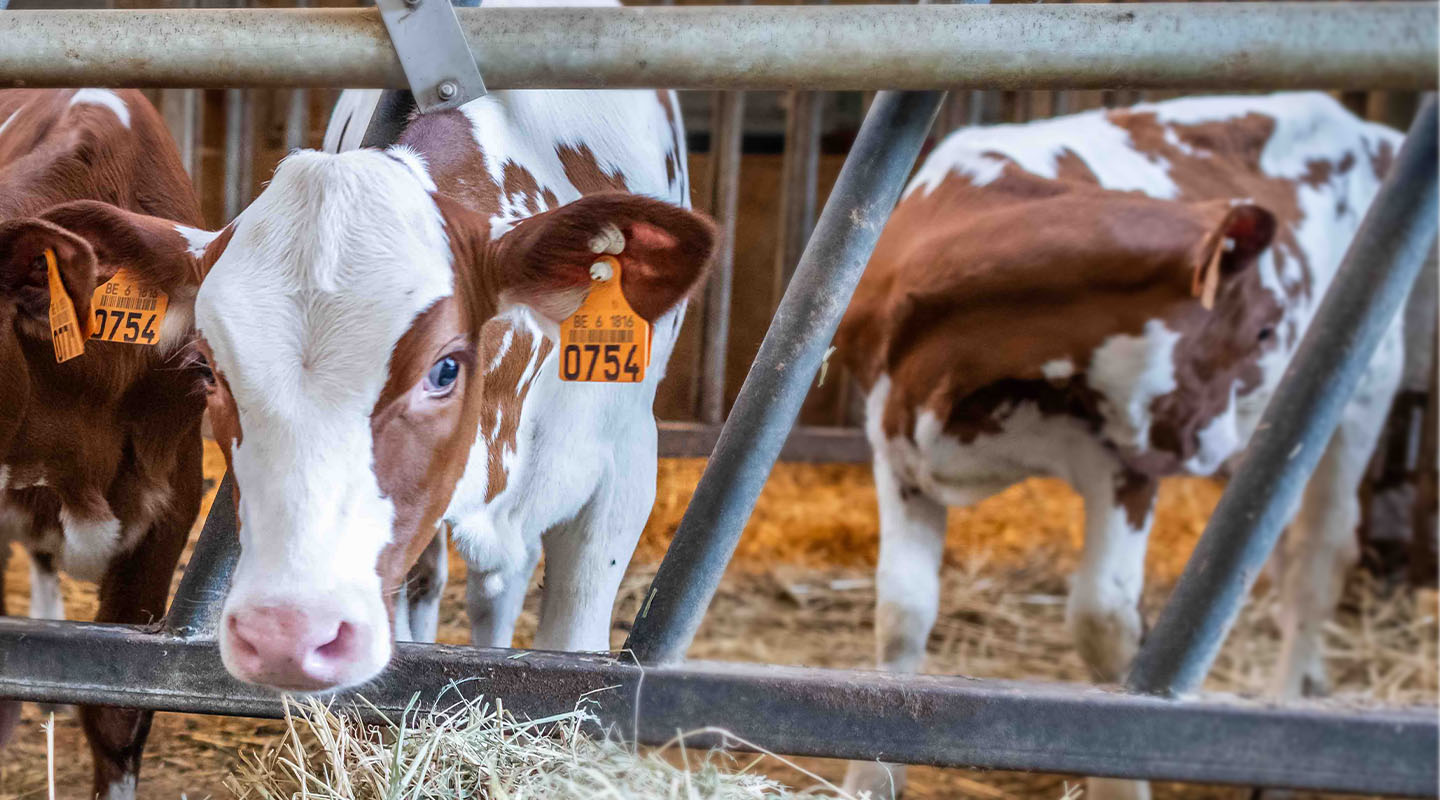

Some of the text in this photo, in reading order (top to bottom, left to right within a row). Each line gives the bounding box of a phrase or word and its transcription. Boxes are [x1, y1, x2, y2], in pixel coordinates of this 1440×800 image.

[105, 282, 119, 295] BE
[124, 285, 131, 295] 6
[90, 308, 157, 343] 0754
[574, 315, 588, 328] BE
[595, 315, 602, 328] 6
[564, 344, 639, 382] 0754
